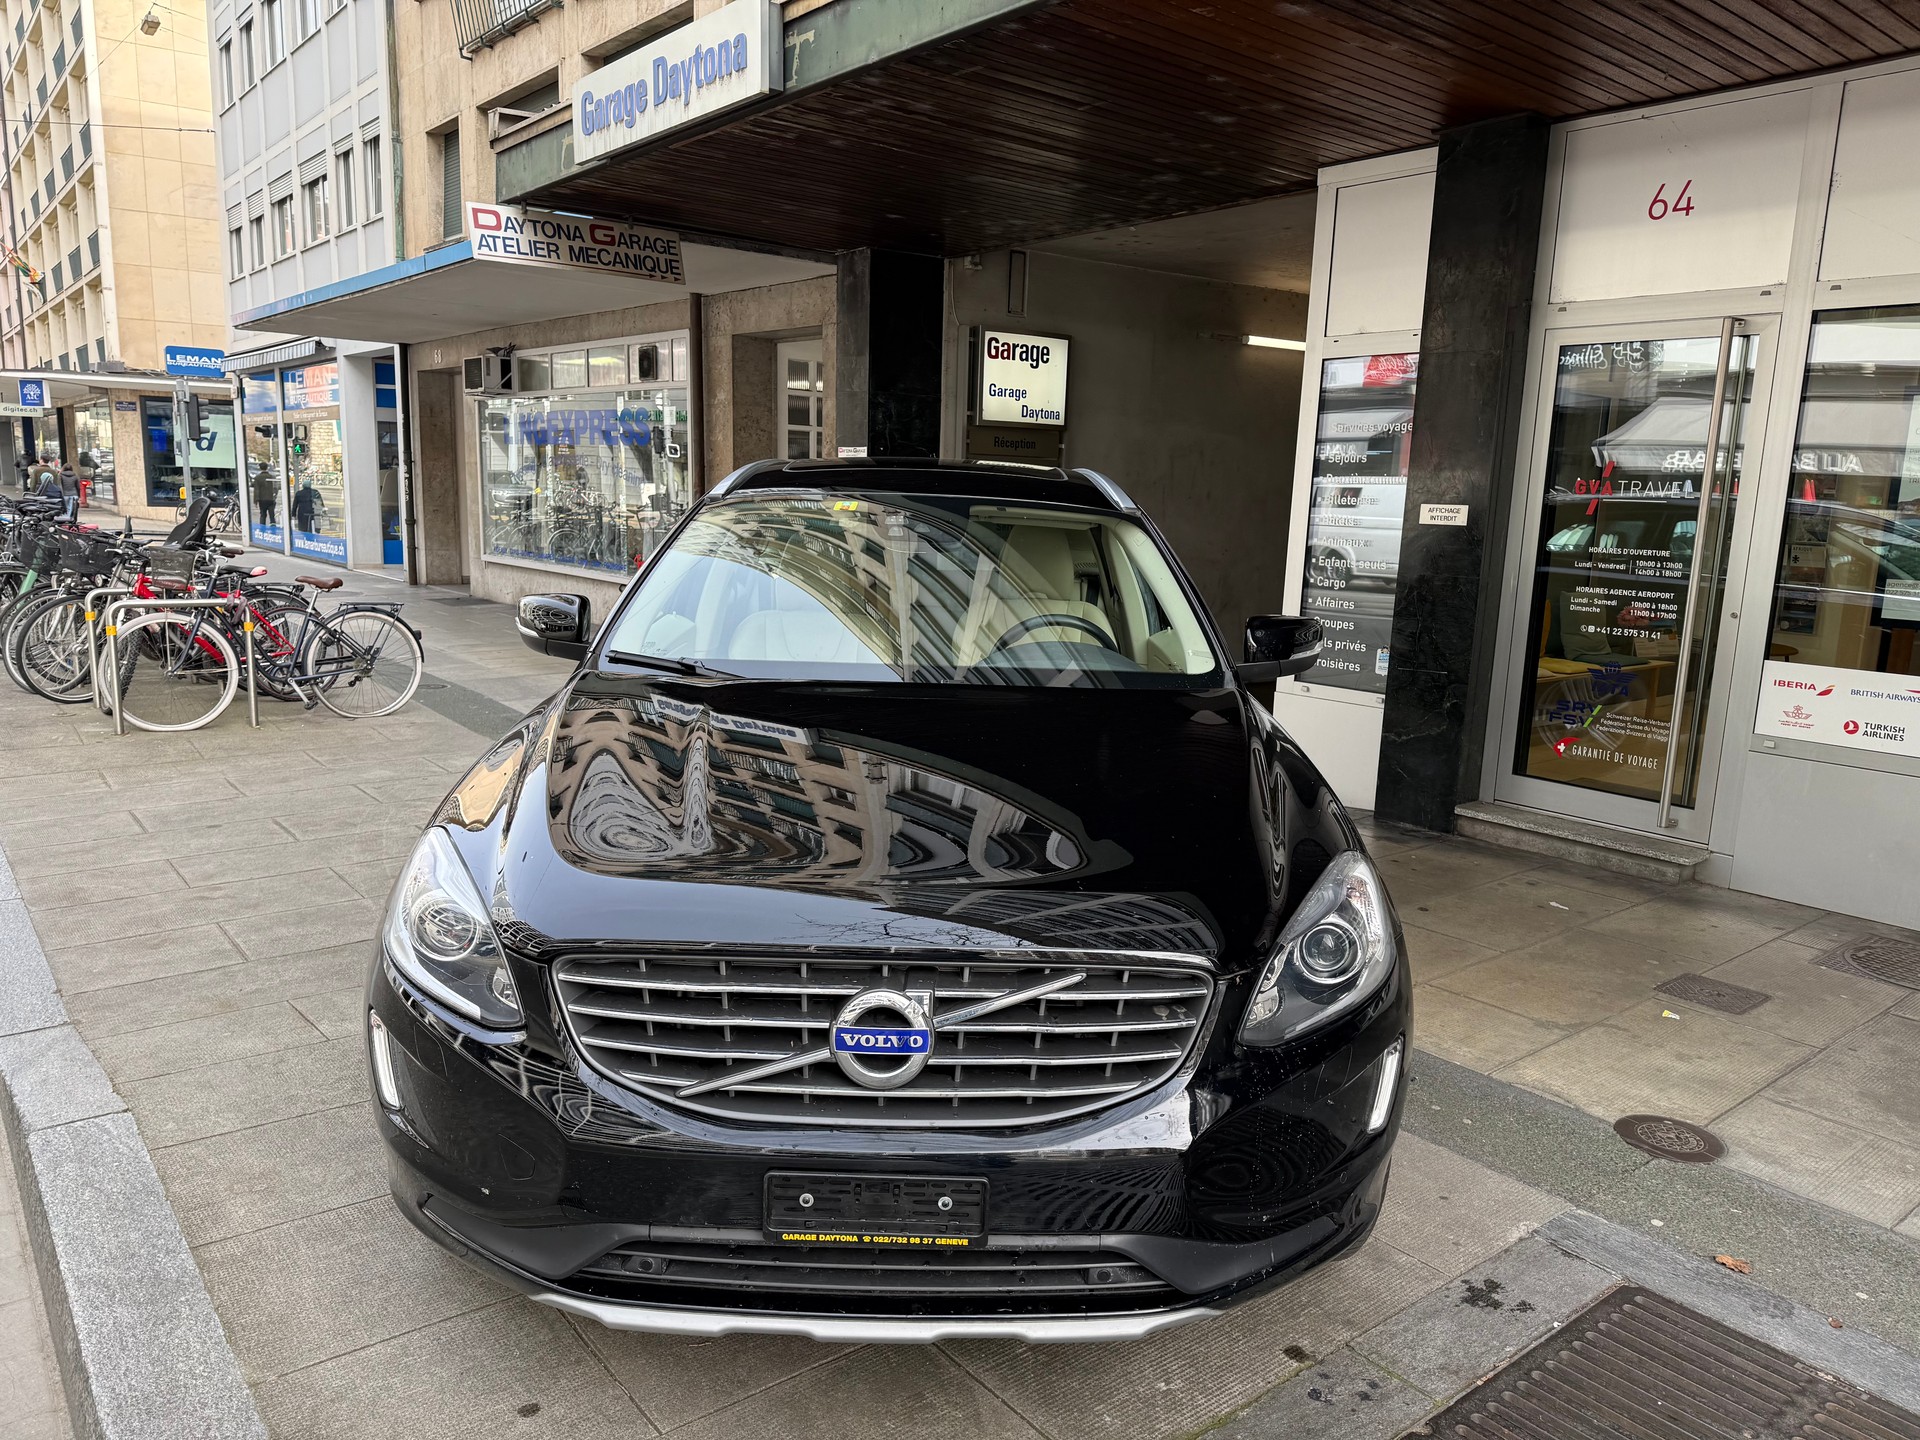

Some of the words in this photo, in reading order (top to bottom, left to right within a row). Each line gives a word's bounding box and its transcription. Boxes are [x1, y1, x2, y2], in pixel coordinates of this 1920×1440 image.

[580, 76, 648, 136] Garage
[652, 32, 748, 106] Daytona
[1648, 180, 1695, 220] 64
[472, 207, 585, 243] DAYTONA
[589, 223, 677, 256] GARAGE
[477, 234, 560, 260] ATELIER
[568, 245, 681, 276] MECANIQUE
[166, 353, 221, 364] LEMAN
[987, 336, 1050, 369] Garage
[988, 383, 1027, 401] Garage
[2, 405, 38, 413] digitec.ch
[1021, 404, 1060, 421] Daytona
[993, 435, 1036, 450] Réception
[1575, 479, 1614, 497] GVA
[1618, 480, 1695, 498] TRAVEL
[1321, 536, 1365, 548] Animaux
[1589, 546, 1622, 554] HORAIRES
[1623, 548, 1670, 557] D'OUVERTURE
[1318, 556, 1356, 568] Enfants
[1359, 560, 1387, 570] seuls
[1597, 562, 1626, 570] Vendredi
[1663, 561, 1683, 569] 13h00
[1316, 576, 1346, 590] Cargo
[1576, 586, 1608, 594] HORAIRES
[1637, 591, 1675, 599] AEROPORT
[1315, 596, 1355, 610] Affaires
[1593, 598, 1618, 606] Samedi
[1658, 603, 1678, 611] 18h00
[1570, 605, 1601, 613] Dimanche
[1657, 611, 1677, 619] 17h00
[1612, 628, 1622, 636] 22
[1623, 629, 1638, 637] 575
[1640, 630, 1649, 638] 31
[1651, 631, 1660, 639] 41
[1334, 639, 1367, 652] privés
[1315, 658, 1361, 672] roisières
[1773, 679, 1817, 691] IBERIA
[1850, 689, 1884, 699] BRITISH
[1885, 693, 1920, 703] AIRWAYS
[1600, 718, 1626, 727] Fédération
[1626, 722, 1643, 731] Suisse
[1651, 726, 1670, 735] Voyage
[1606, 712, 1632, 721] Schweizer
[1632, 716, 1671, 727] Reise-Verband
[1595, 724, 1626, 734] Federazione
[1864, 722, 1905, 734] TURKISH
[1862, 730, 1905, 742] AIRLINES
[1572, 744, 1611, 762] GARANTIE
[1614, 752, 1624, 764] DE
[1627, 755, 1658, 770] VOYAGE
[841, 1033, 923, 1048] VOLVO
[782, 1233, 817, 1241] GARAGE
[819, 1234, 858, 1242] DAYTONA
[873, 1236, 907, 1244] 022/732
[935, 1238, 969, 1246] GENEVE
